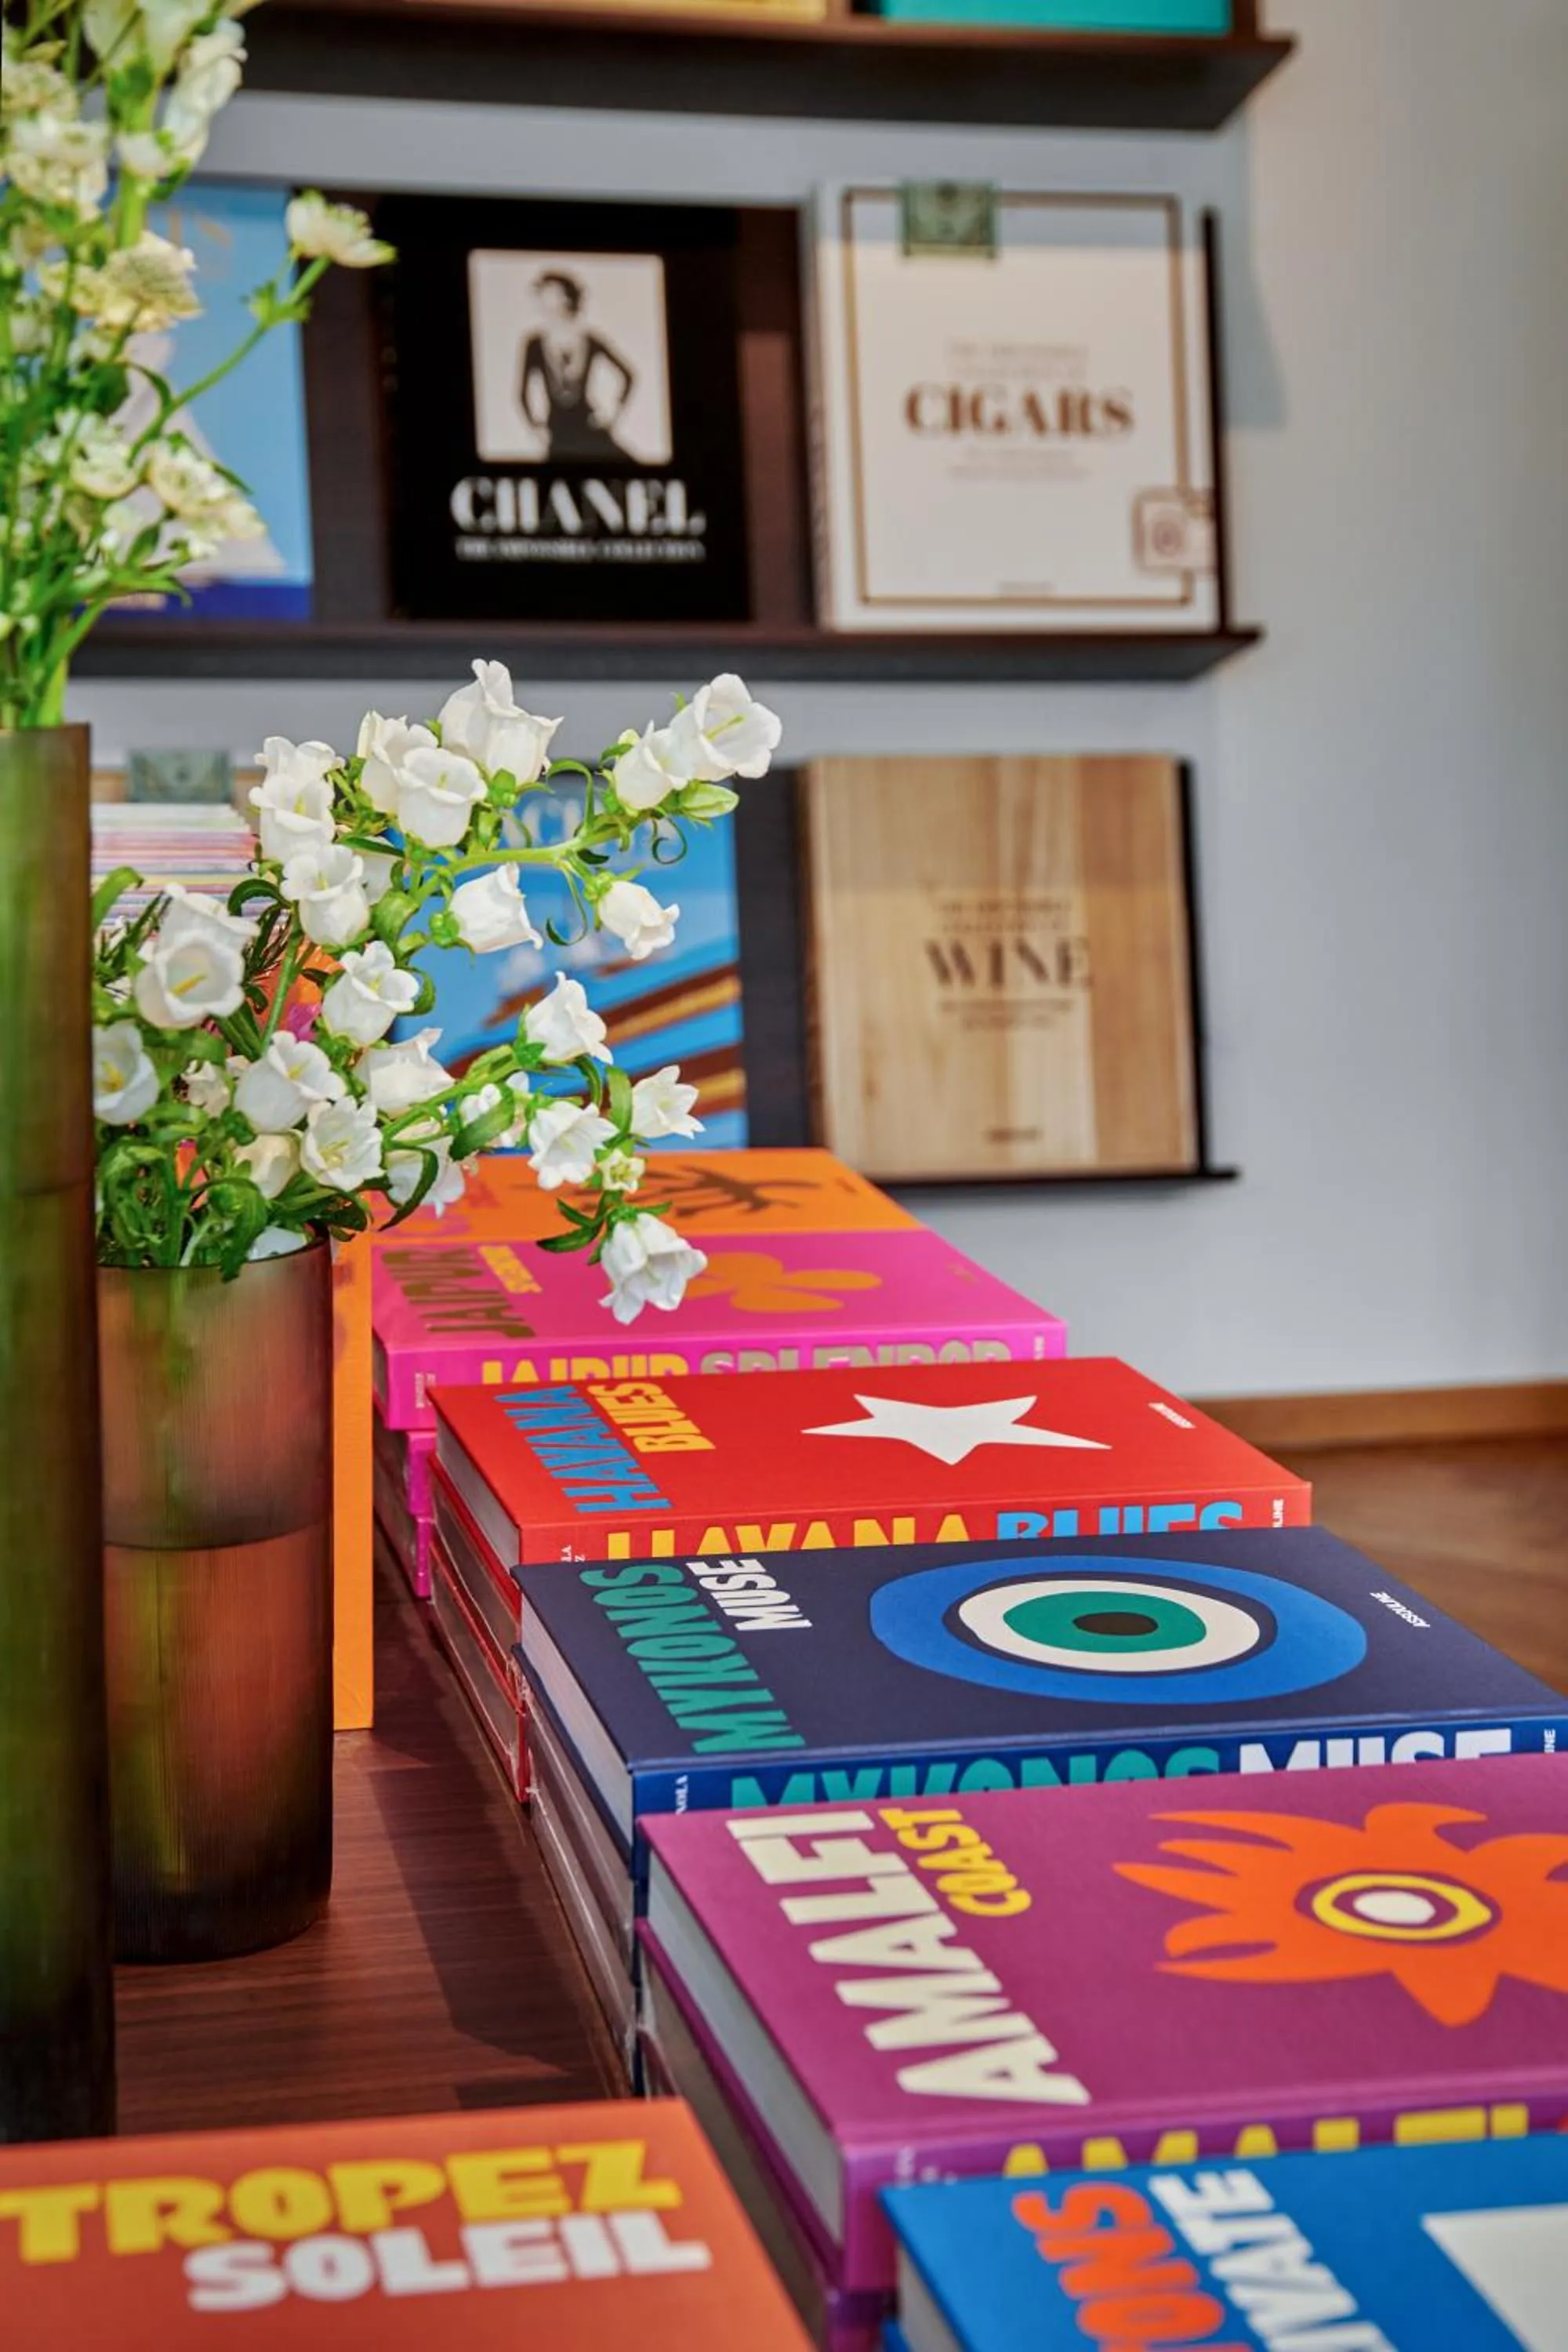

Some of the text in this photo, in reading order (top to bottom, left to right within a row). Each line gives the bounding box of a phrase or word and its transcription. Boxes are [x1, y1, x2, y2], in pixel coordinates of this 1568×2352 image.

[903, 383, 1135, 439] CIGARS
[450, 476, 706, 534] CHANEL
[924, 937, 1094, 990] WINE
[494, 1385, 673, 1513] HAVANA
[586, 1381, 717, 1454] BLUES
[684, 1557, 814, 1631] MUSE
[579, 1563, 806, 1754] MYKONOS
[878, 1808, 1033, 1917] COAST
[726, 1809, 1091, 2106] AMALFI
[0, 2140, 682, 2264] TROPEZ
[183, 2209, 712, 2311] SOLEIL
